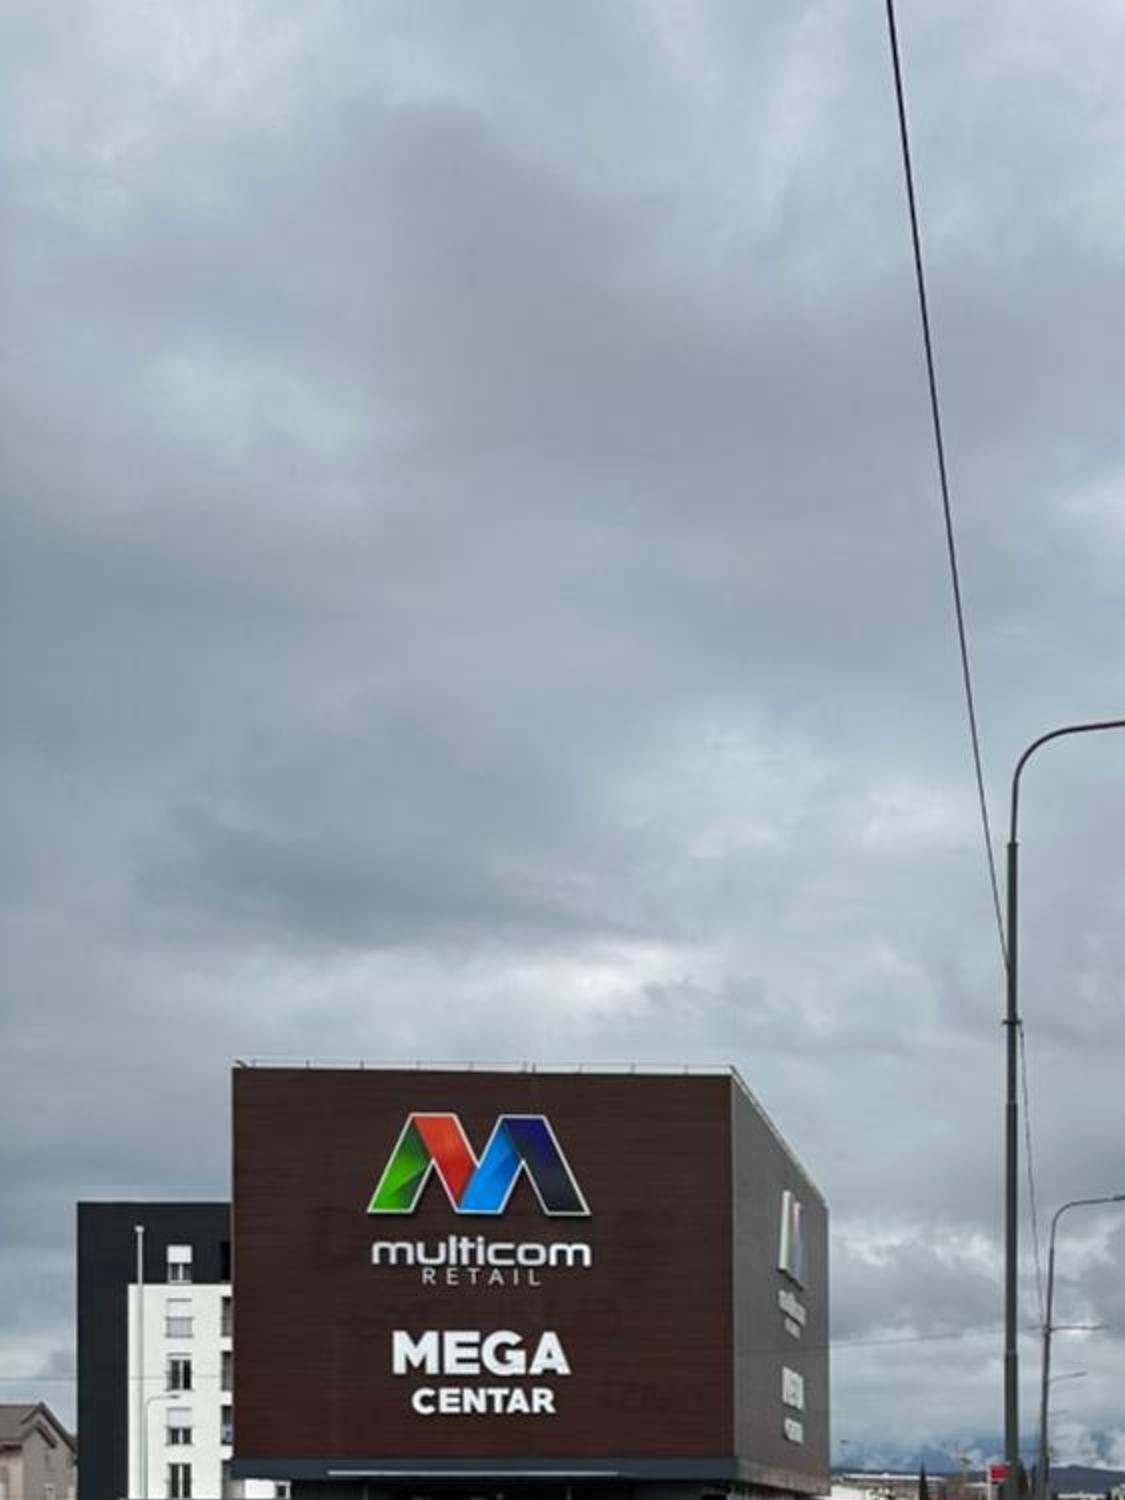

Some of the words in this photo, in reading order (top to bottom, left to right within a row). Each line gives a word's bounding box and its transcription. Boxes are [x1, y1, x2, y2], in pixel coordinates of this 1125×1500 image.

[371, 1235, 592, 1267] multicom
[421, 1267, 542, 1286] RETAIL
[392, 1330, 572, 1376] MEGA
[411, 1387, 556, 1415] CENTAR
